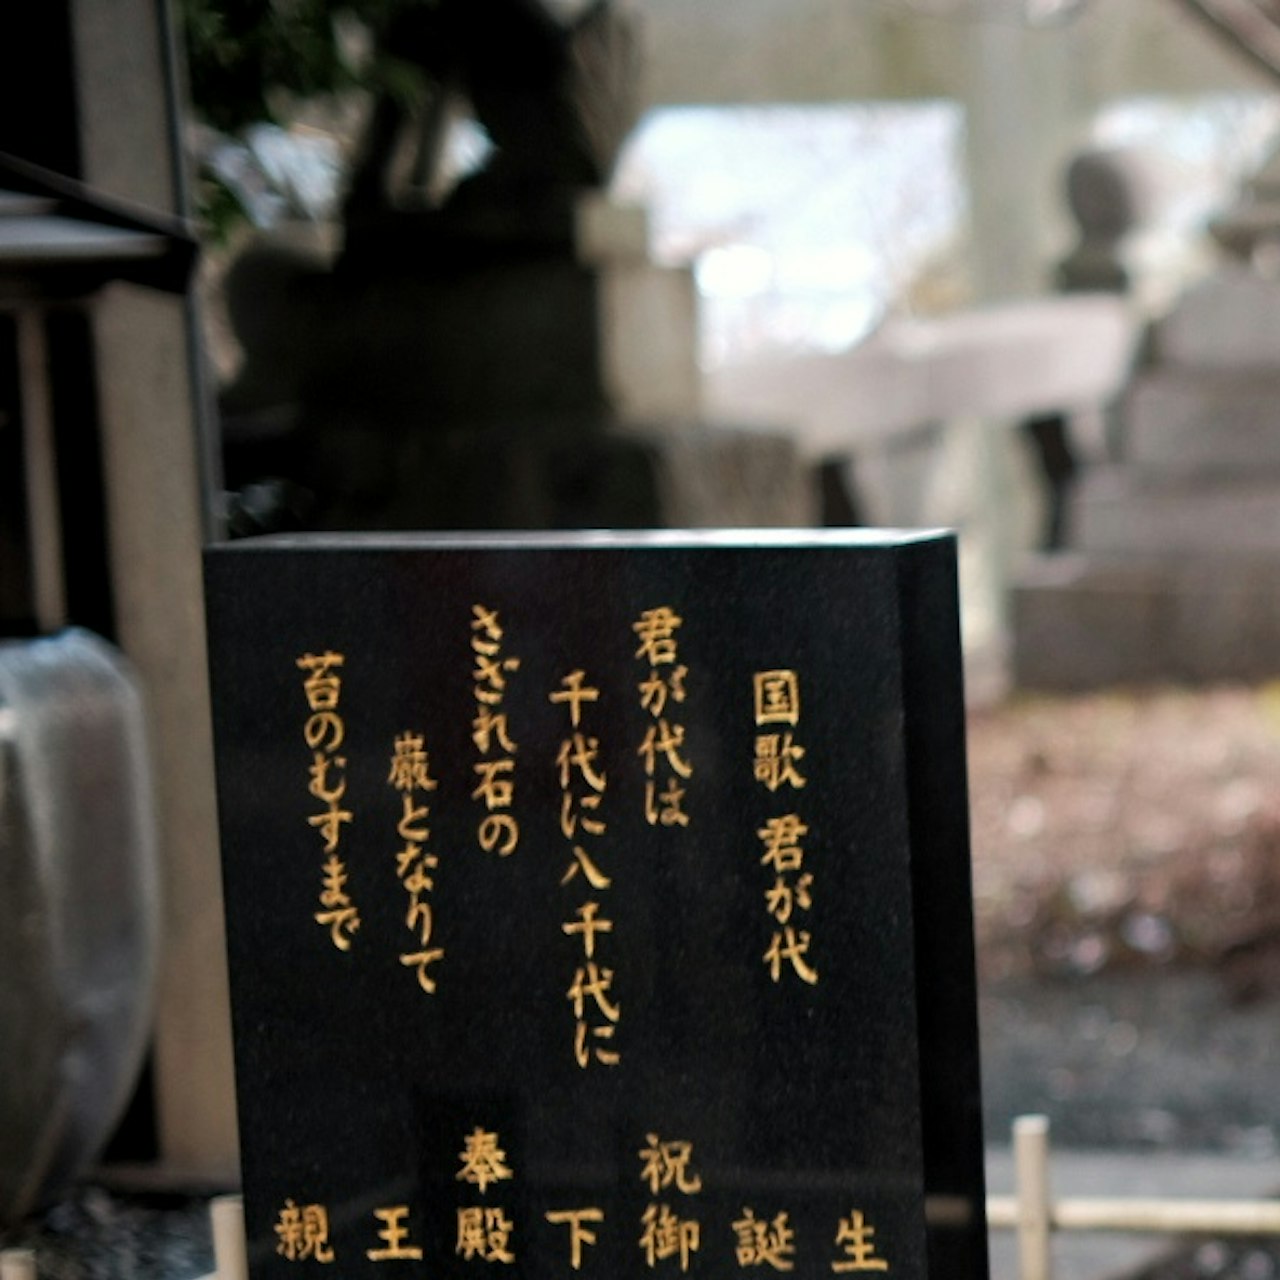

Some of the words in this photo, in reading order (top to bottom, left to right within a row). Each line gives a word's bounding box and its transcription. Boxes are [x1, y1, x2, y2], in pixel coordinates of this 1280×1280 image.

[296, 651, 361, 951] 苔のむすまで
[471, 604, 521, 856] さざれ石の
[633, 606, 693, 826] 君が代は
[753, 669, 806, 791] 国歌
[388, 731, 444, 993] 巌となりて
[549, 670, 620, 1068] 千代に八千代に
[757, 814, 818, 984] 君が代
